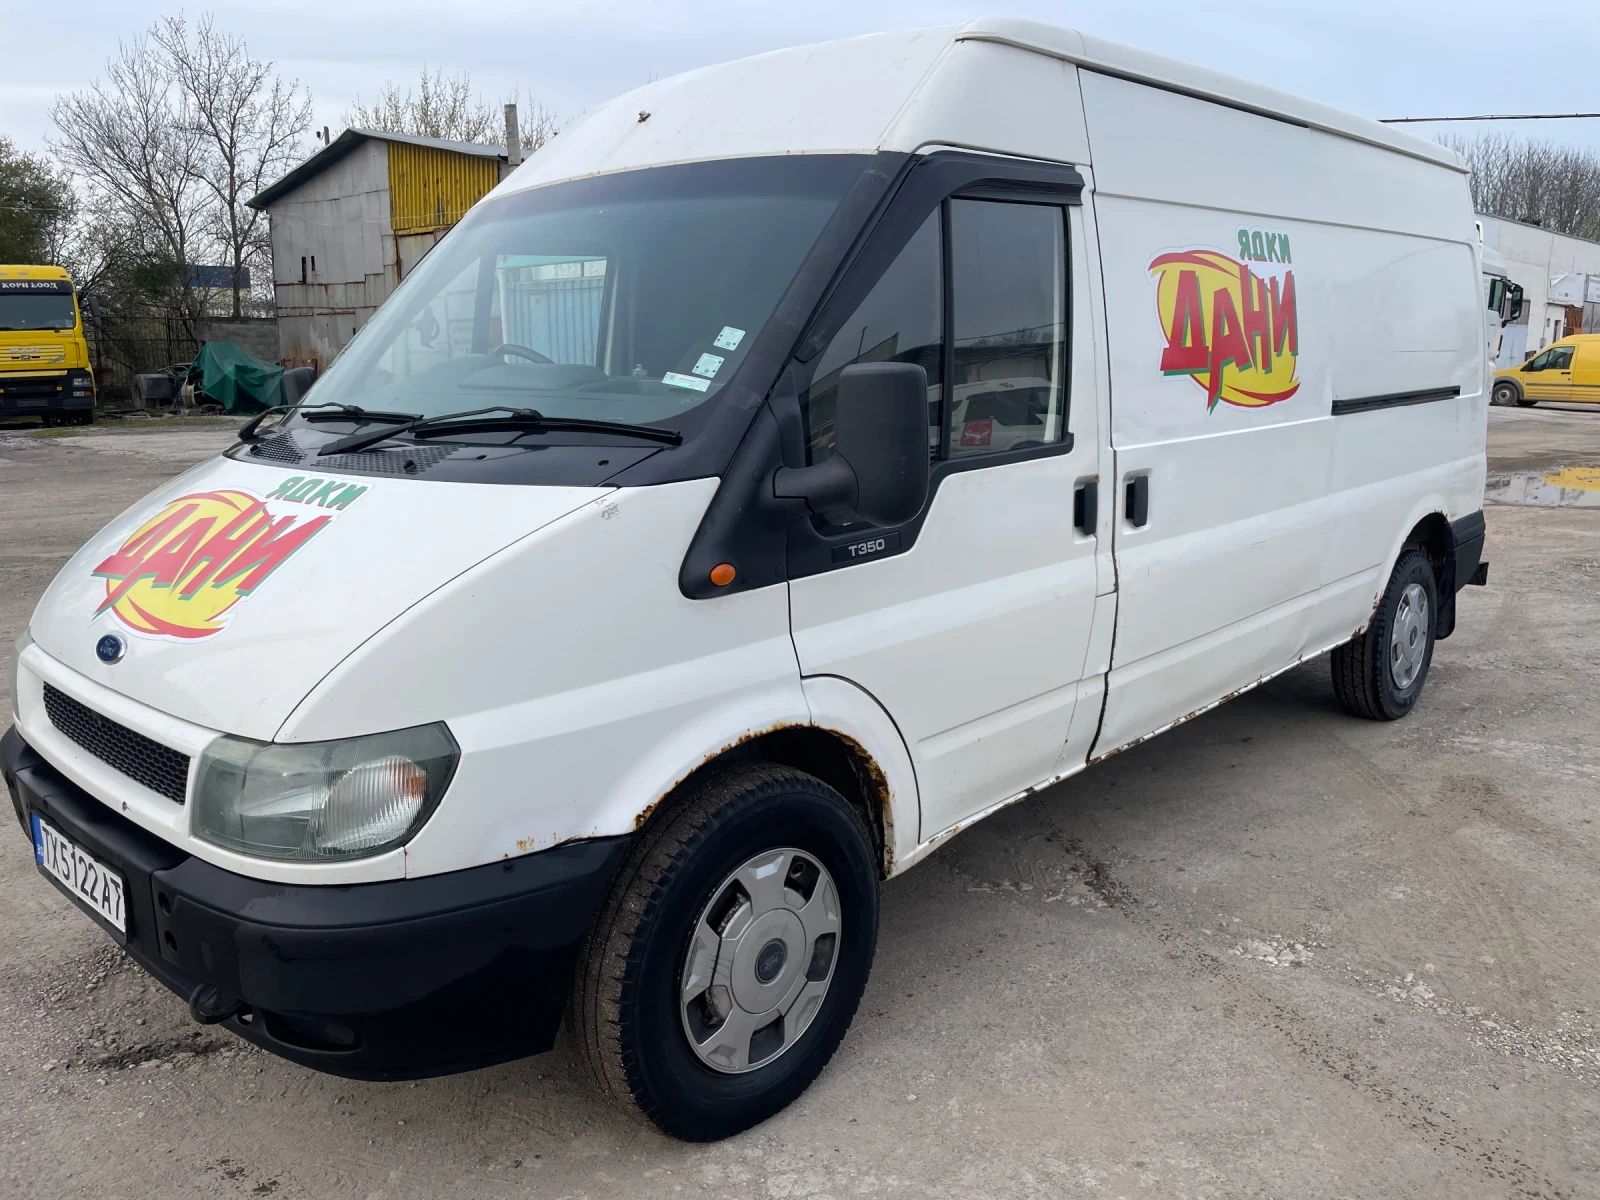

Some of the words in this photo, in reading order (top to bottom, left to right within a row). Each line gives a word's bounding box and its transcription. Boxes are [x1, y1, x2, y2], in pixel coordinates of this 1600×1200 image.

[1237, 229, 1292, 264] ЯДКИ
[1160, 265, 1299, 416] ДАНИ
[265, 476, 368, 511] ЯДКИ
[91, 502, 332, 621] ДАНИ
[848, 538, 885, 557] T350
